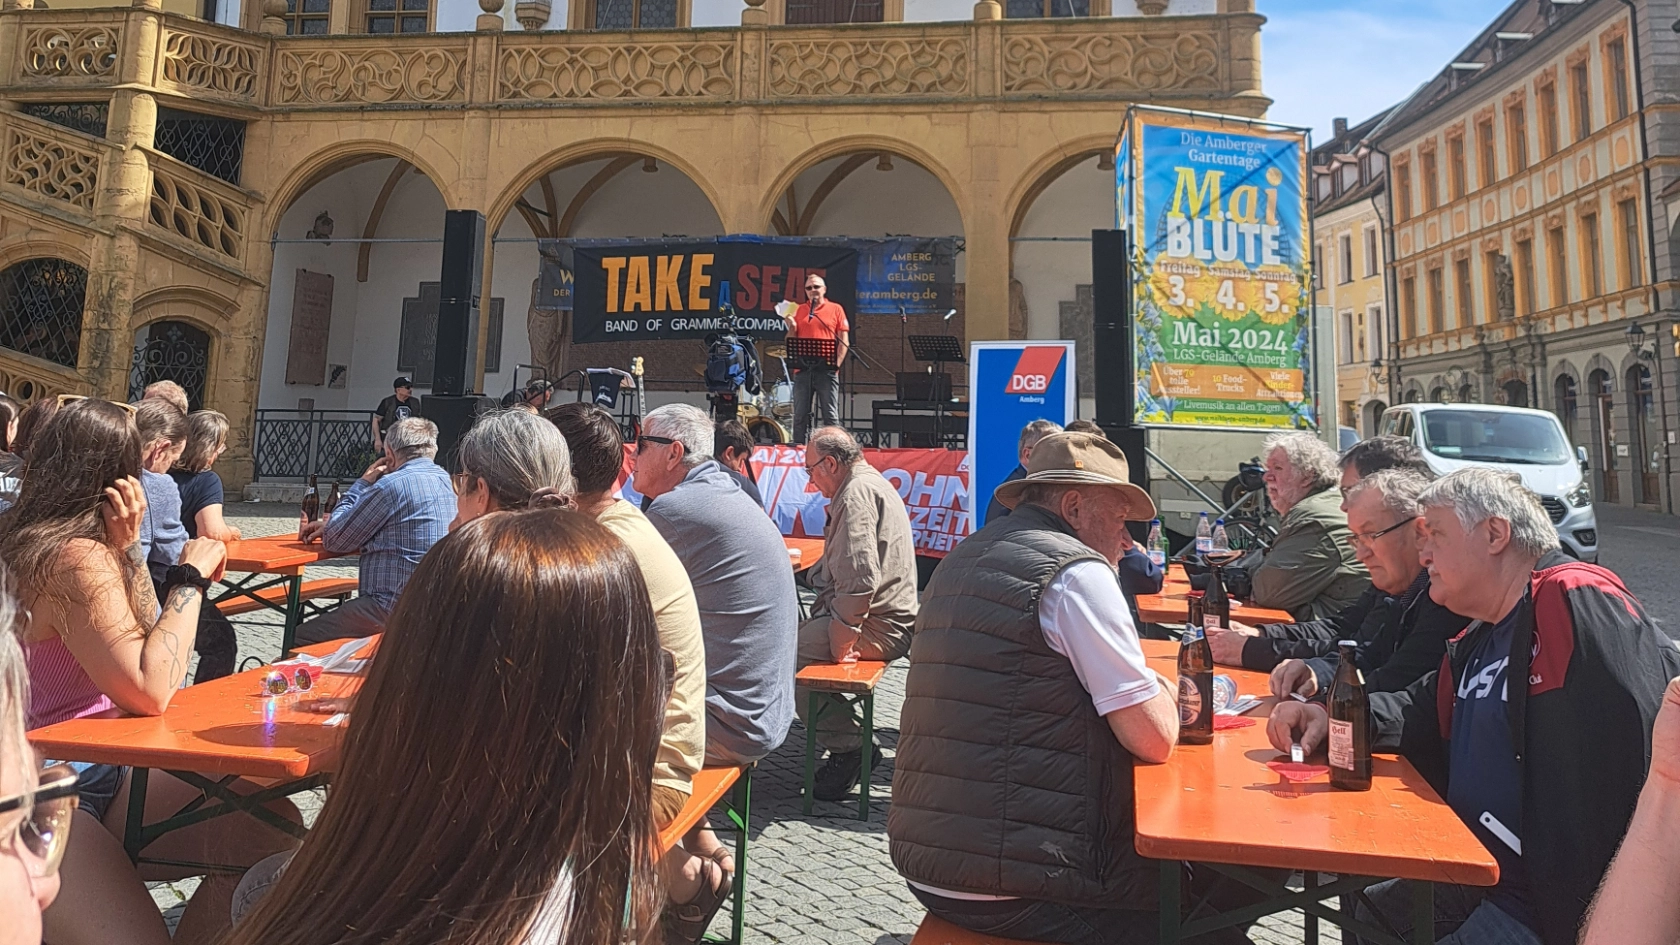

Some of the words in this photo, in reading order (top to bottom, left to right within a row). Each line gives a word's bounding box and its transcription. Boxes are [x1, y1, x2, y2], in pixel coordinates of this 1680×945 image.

[1180, 132, 1202, 146] Die
[1204, 135, 1267, 155] Amberger
[1188, 149, 1261, 171] Gartentage
[1167, 166, 1283, 226] Mai
[1167, 210, 1281, 265] BLÜTE
[891, 253, 932, 262] AMBERG
[899, 263, 923, 271] LGS-
[1160, 260, 1201, 277] Freitag
[1208, 265, 1250, 281] Samstag
[1254, 269, 1297, 284] Sonntag
[602, 253, 715, 313] TAKE
[718, 280, 731, 309] A
[887, 271, 935, 281] GELÄNDE
[553, 288, 571, 297] DER
[1168, 275, 1194, 307] 3.
[1217, 279, 1245, 311] 4.
[1264, 282, 1290, 313] 5.
[605, 320, 638, 333] BAND
[646, 319, 663, 331] OF
[736, 317, 790, 331] COMPAN
[1172, 321, 1222, 347] Mai
[1227, 328, 1288, 355] 2024
[1173, 348, 1244, 363] LGS-Gelände
[1246, 353, 1287, 368] Amberg
[1163, 365, 1183, 376] Über
[1270, 371, 1291, 380] Viele
[1012, 374, 1047, 391] DGB
[1169, 376, 1189, 385] tolle
[1223, 374, 1248, 384] Food-
[1019, 396, 1045, 405] Amberg
[1184, 400, 1224, 411] Livemusik
[1237, 402, 1256, 411] allen
[1257, 403, 1281, 413] Tagen
[881, 468, 970, 512] OHN
